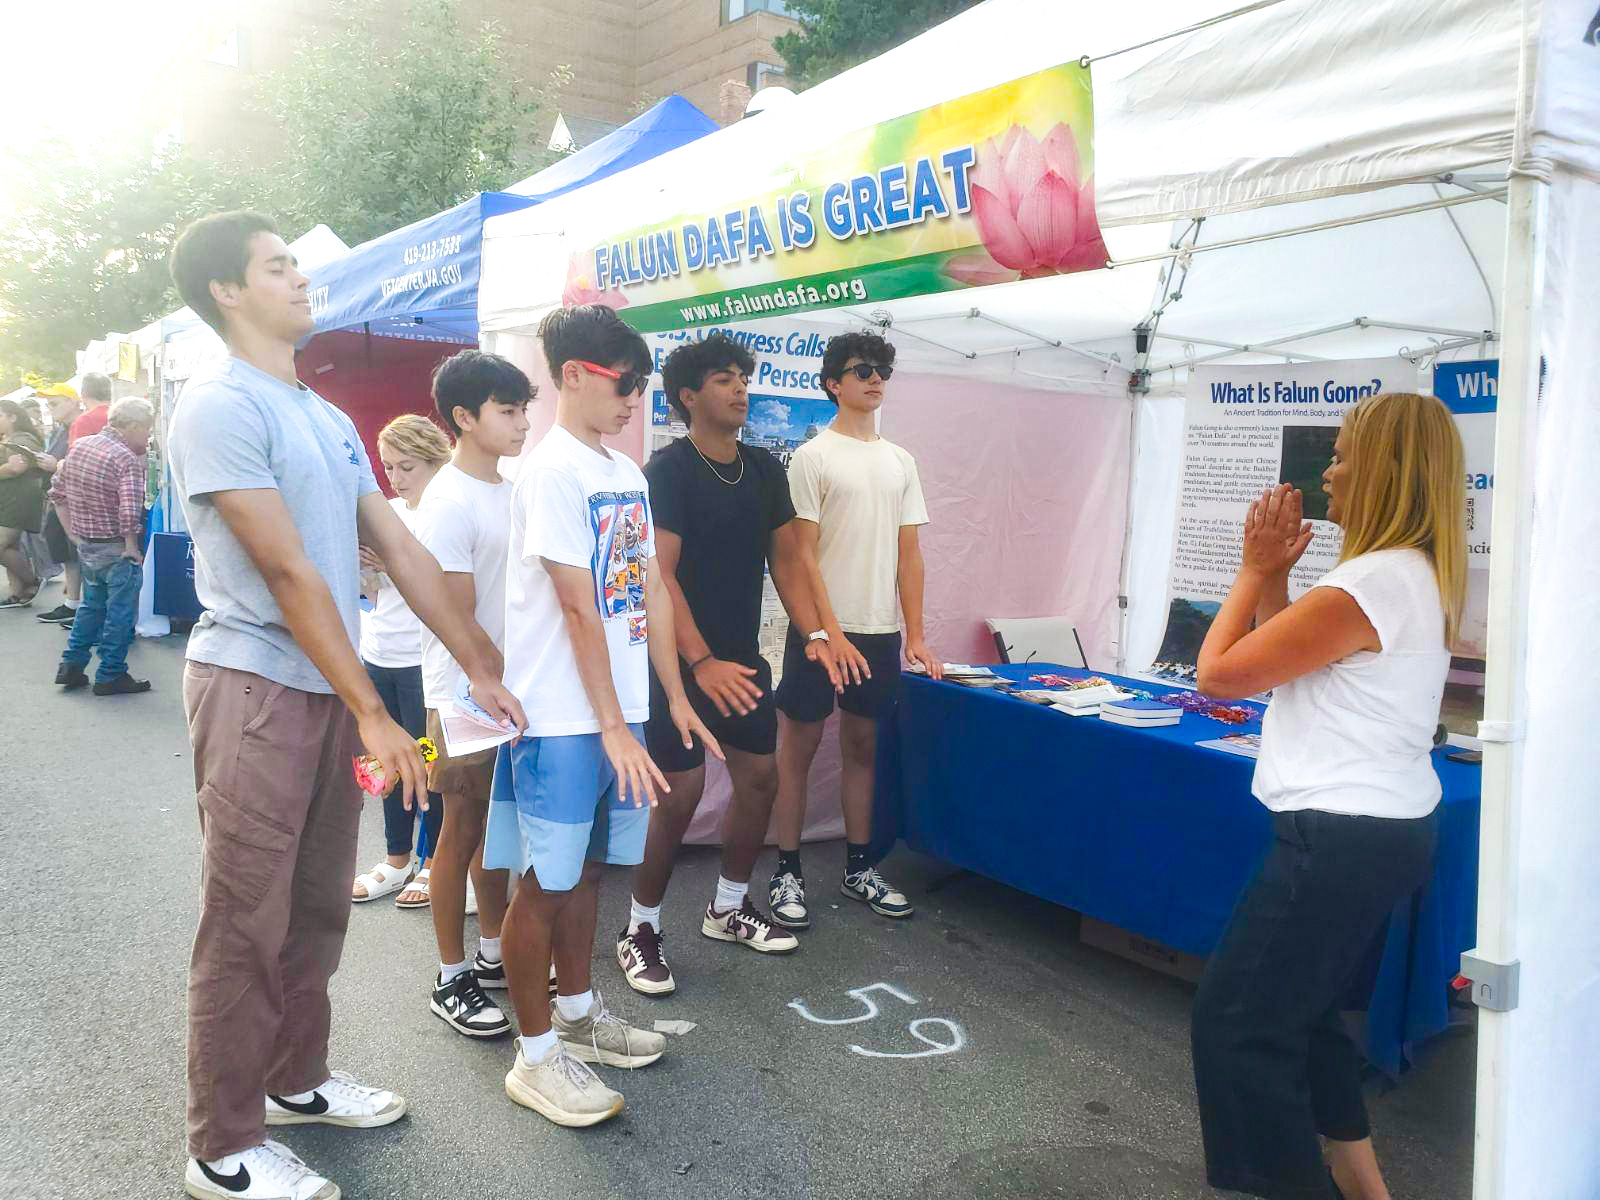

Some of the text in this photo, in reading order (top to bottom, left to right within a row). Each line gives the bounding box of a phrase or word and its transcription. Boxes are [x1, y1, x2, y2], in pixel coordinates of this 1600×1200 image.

[594, 144, 976, 290] FALUN DAFA IS GREAT
[679, 278, 867, 322] www.falundafa.org
[786, 332, 825, 357] Calls
[1211, 382, 1254, 404] What
[1258, 382, 1270, 404] Is
[1274, 381, 1319, 403] Falun
[788, 983, 963, 1058] 59
